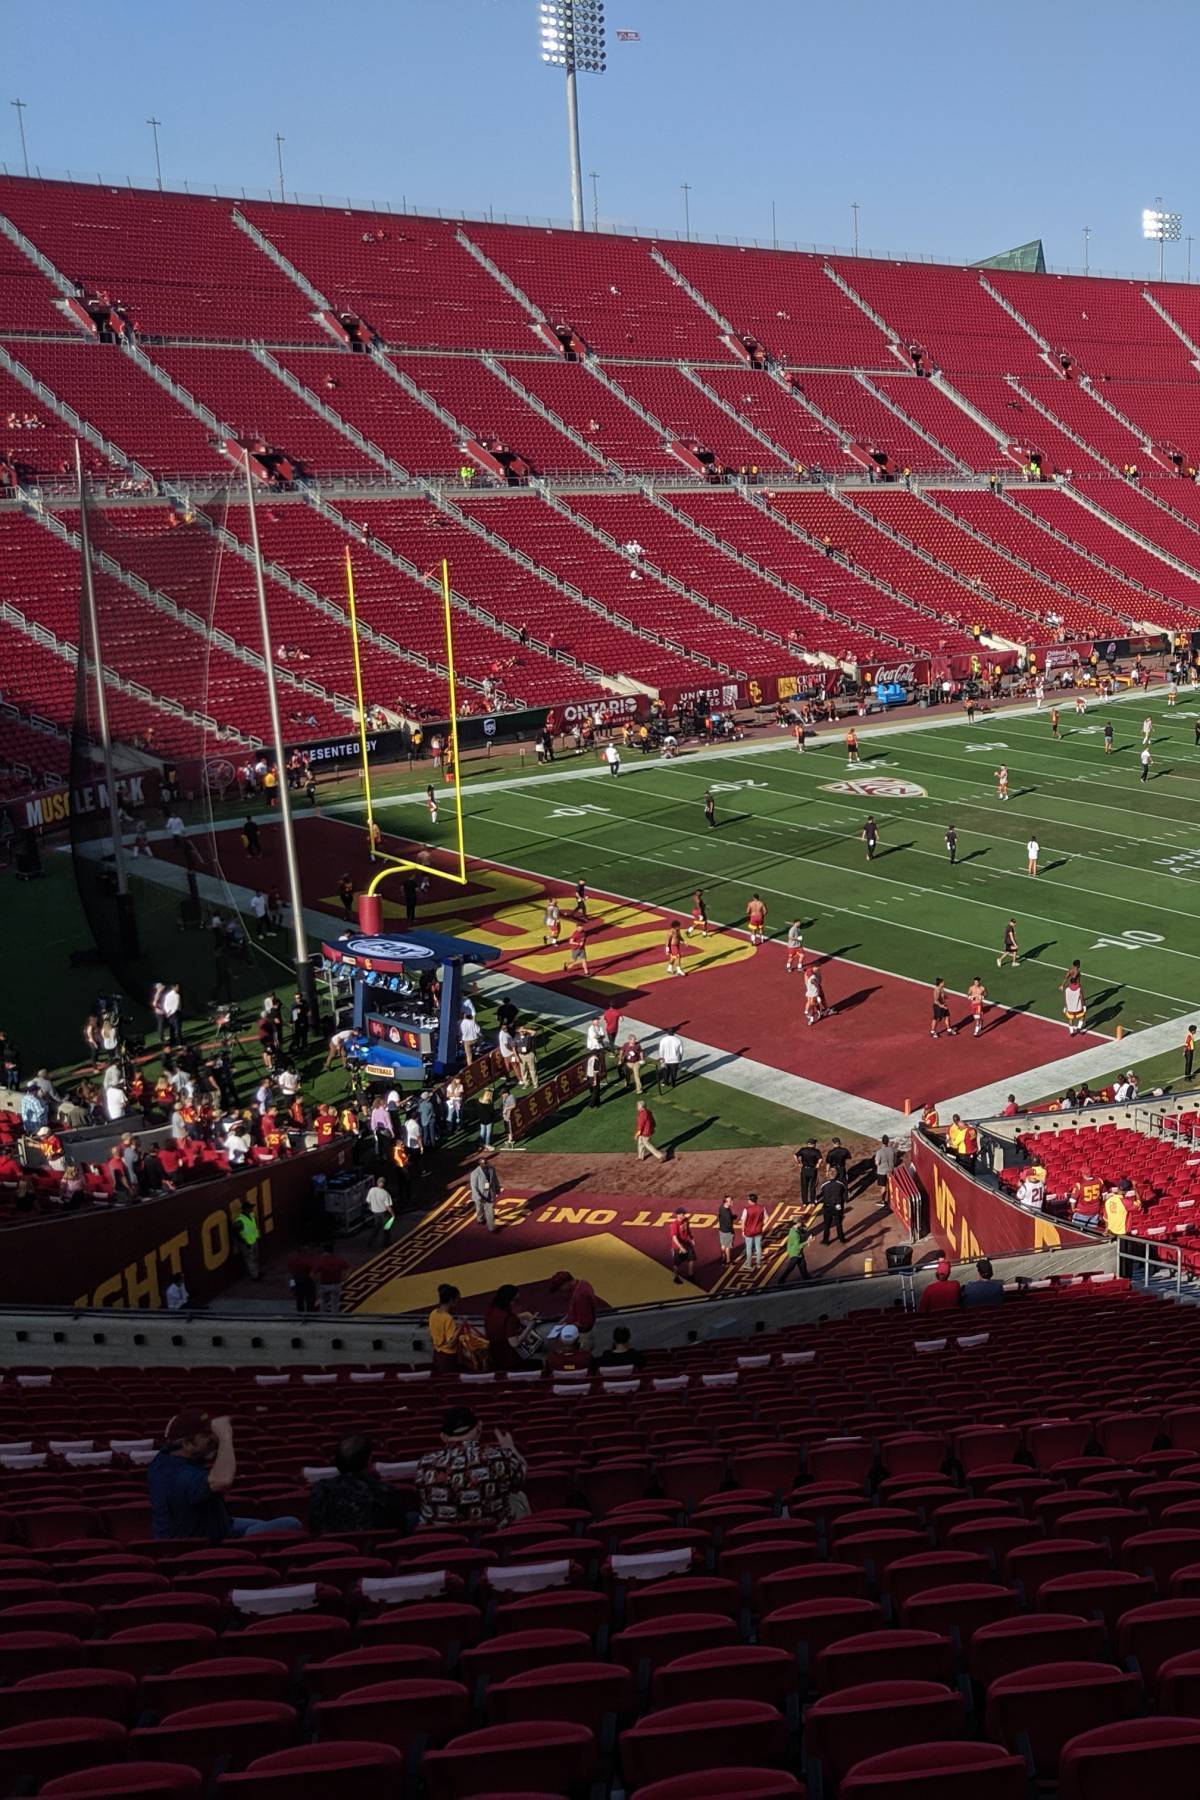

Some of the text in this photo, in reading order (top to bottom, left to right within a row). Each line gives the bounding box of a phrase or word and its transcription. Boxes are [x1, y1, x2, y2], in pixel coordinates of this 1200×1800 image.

[680, 689, 720, 700] UNIED
[564, 697, 638, 721] ONTARIO
[298, 743, 361, 762] ESENTED
[1096, 929, 1166, 950] 10
[1031, 1187, 1044, 1203] 21
[1083, 1185, 1100, 1202] 55
[536, 1205, 618, 1224] ON!
[933, 1162, 957, 1252] WE
